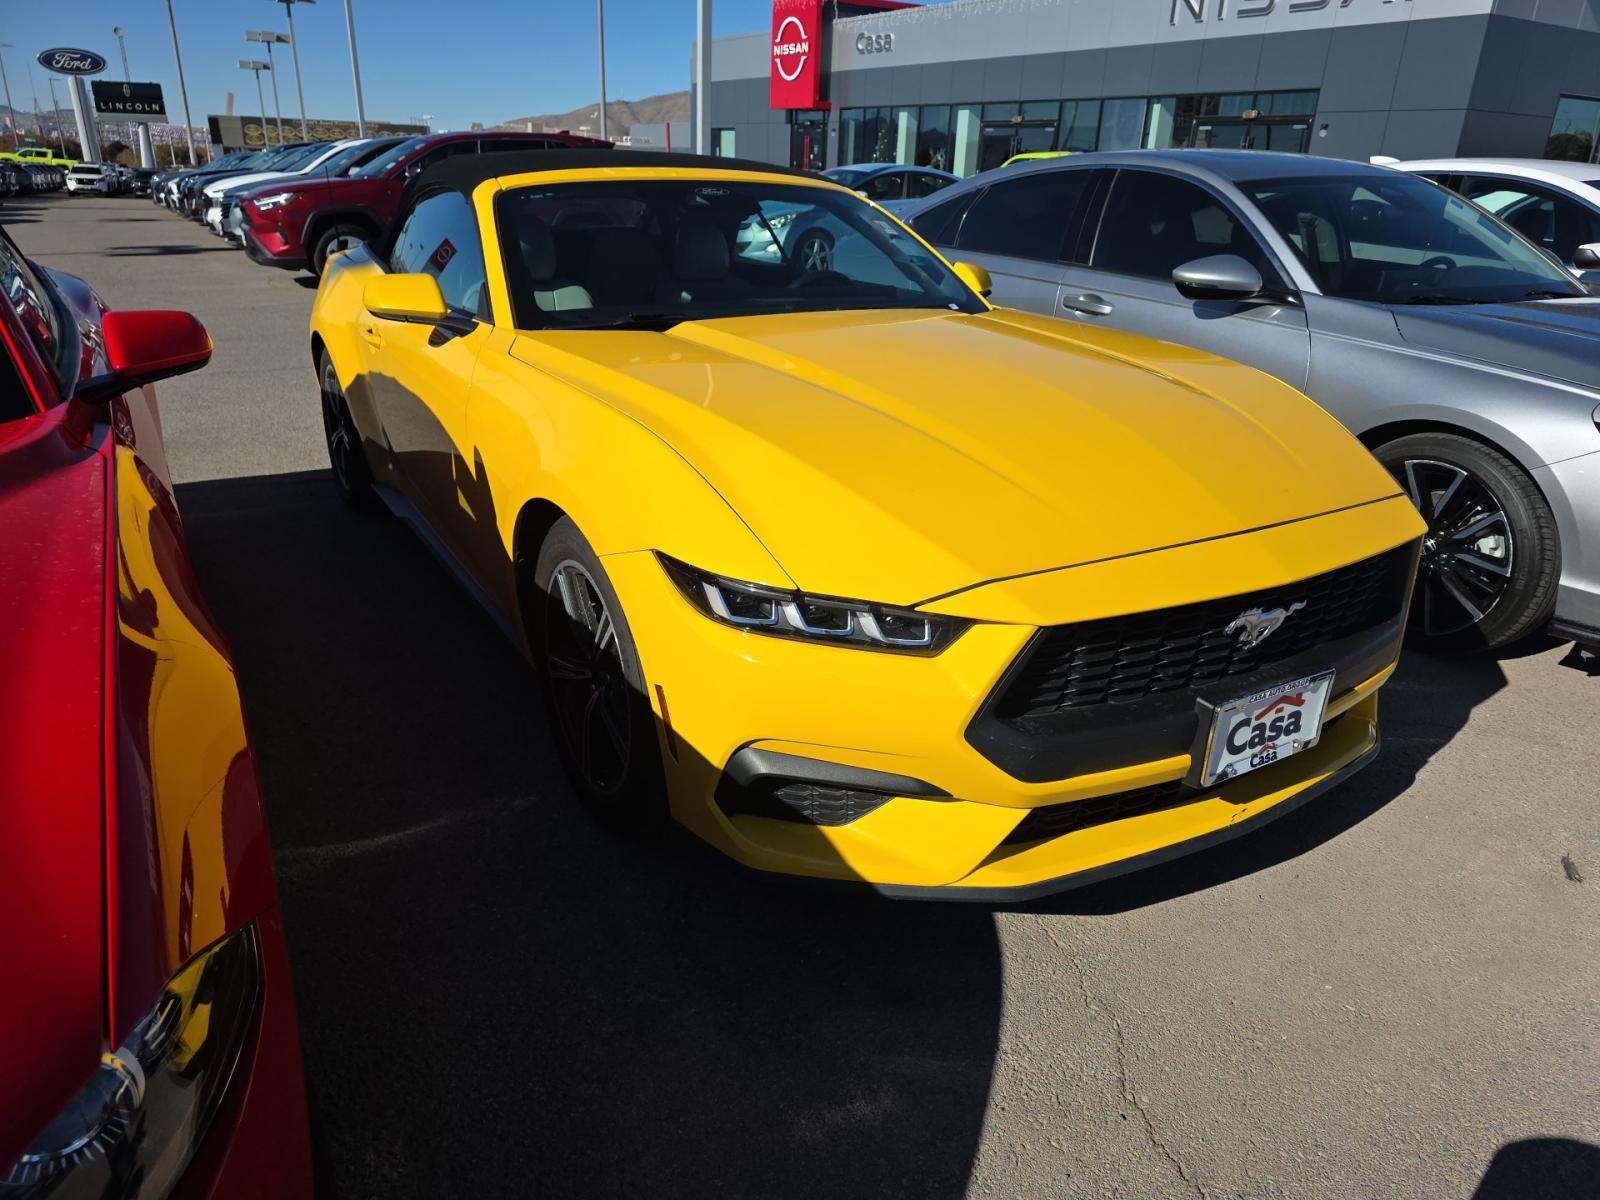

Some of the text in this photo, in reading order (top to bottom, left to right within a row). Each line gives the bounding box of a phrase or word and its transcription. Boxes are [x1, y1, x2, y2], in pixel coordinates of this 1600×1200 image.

[773, 42, 809, 56] NISSAN
[856, 33, 894, 54] Casa
[52, 52, 93, 70] Ford
[100, 101, 160, 112] LINCOLN
[1250, 692, 1270, 703] CASA
[1268, 685, 1286, 698] AUTO
[1226, 710, 1303, 756] Casa
[1249, 750, 1278, 768] Casa
